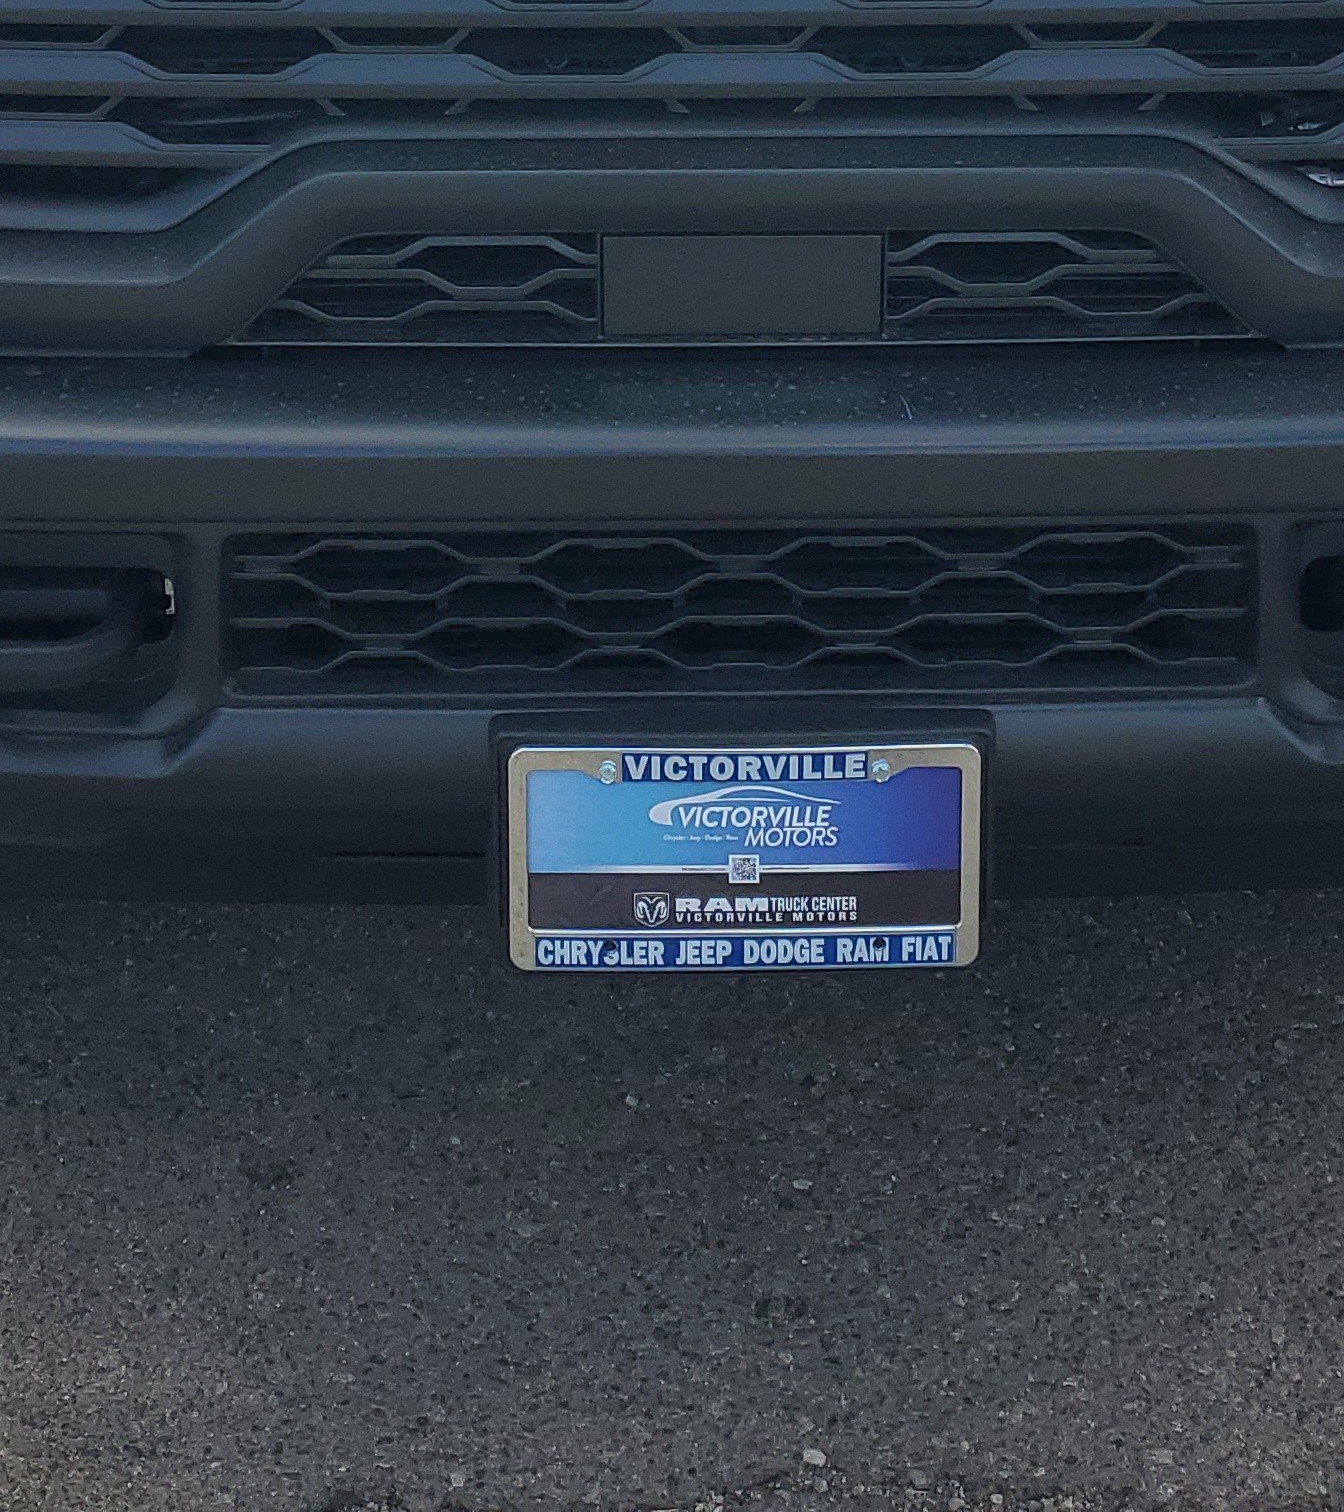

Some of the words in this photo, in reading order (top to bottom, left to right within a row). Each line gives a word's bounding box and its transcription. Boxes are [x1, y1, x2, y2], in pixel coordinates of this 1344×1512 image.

[624, 753, 866, 781] VICTORVILLE
[678, 805, 832, 828] VICTORVILLE
[744, 826, 839, 847] MOTORS
[675, 897, 768, 912] RAM
[770, 897, 808, 912] TRUCK
[811, 896, 857, 912] CENTER
[675, 912, 783, 922] VICTORVILLE
[792, 911, 858, 921] MOTORS
[675, 938, 733, 965] JEEP
[744, 937, 825, 965] DODGE
[835, 937, 890, 964] RAM
[902, 936, 951, 962] FIAT
